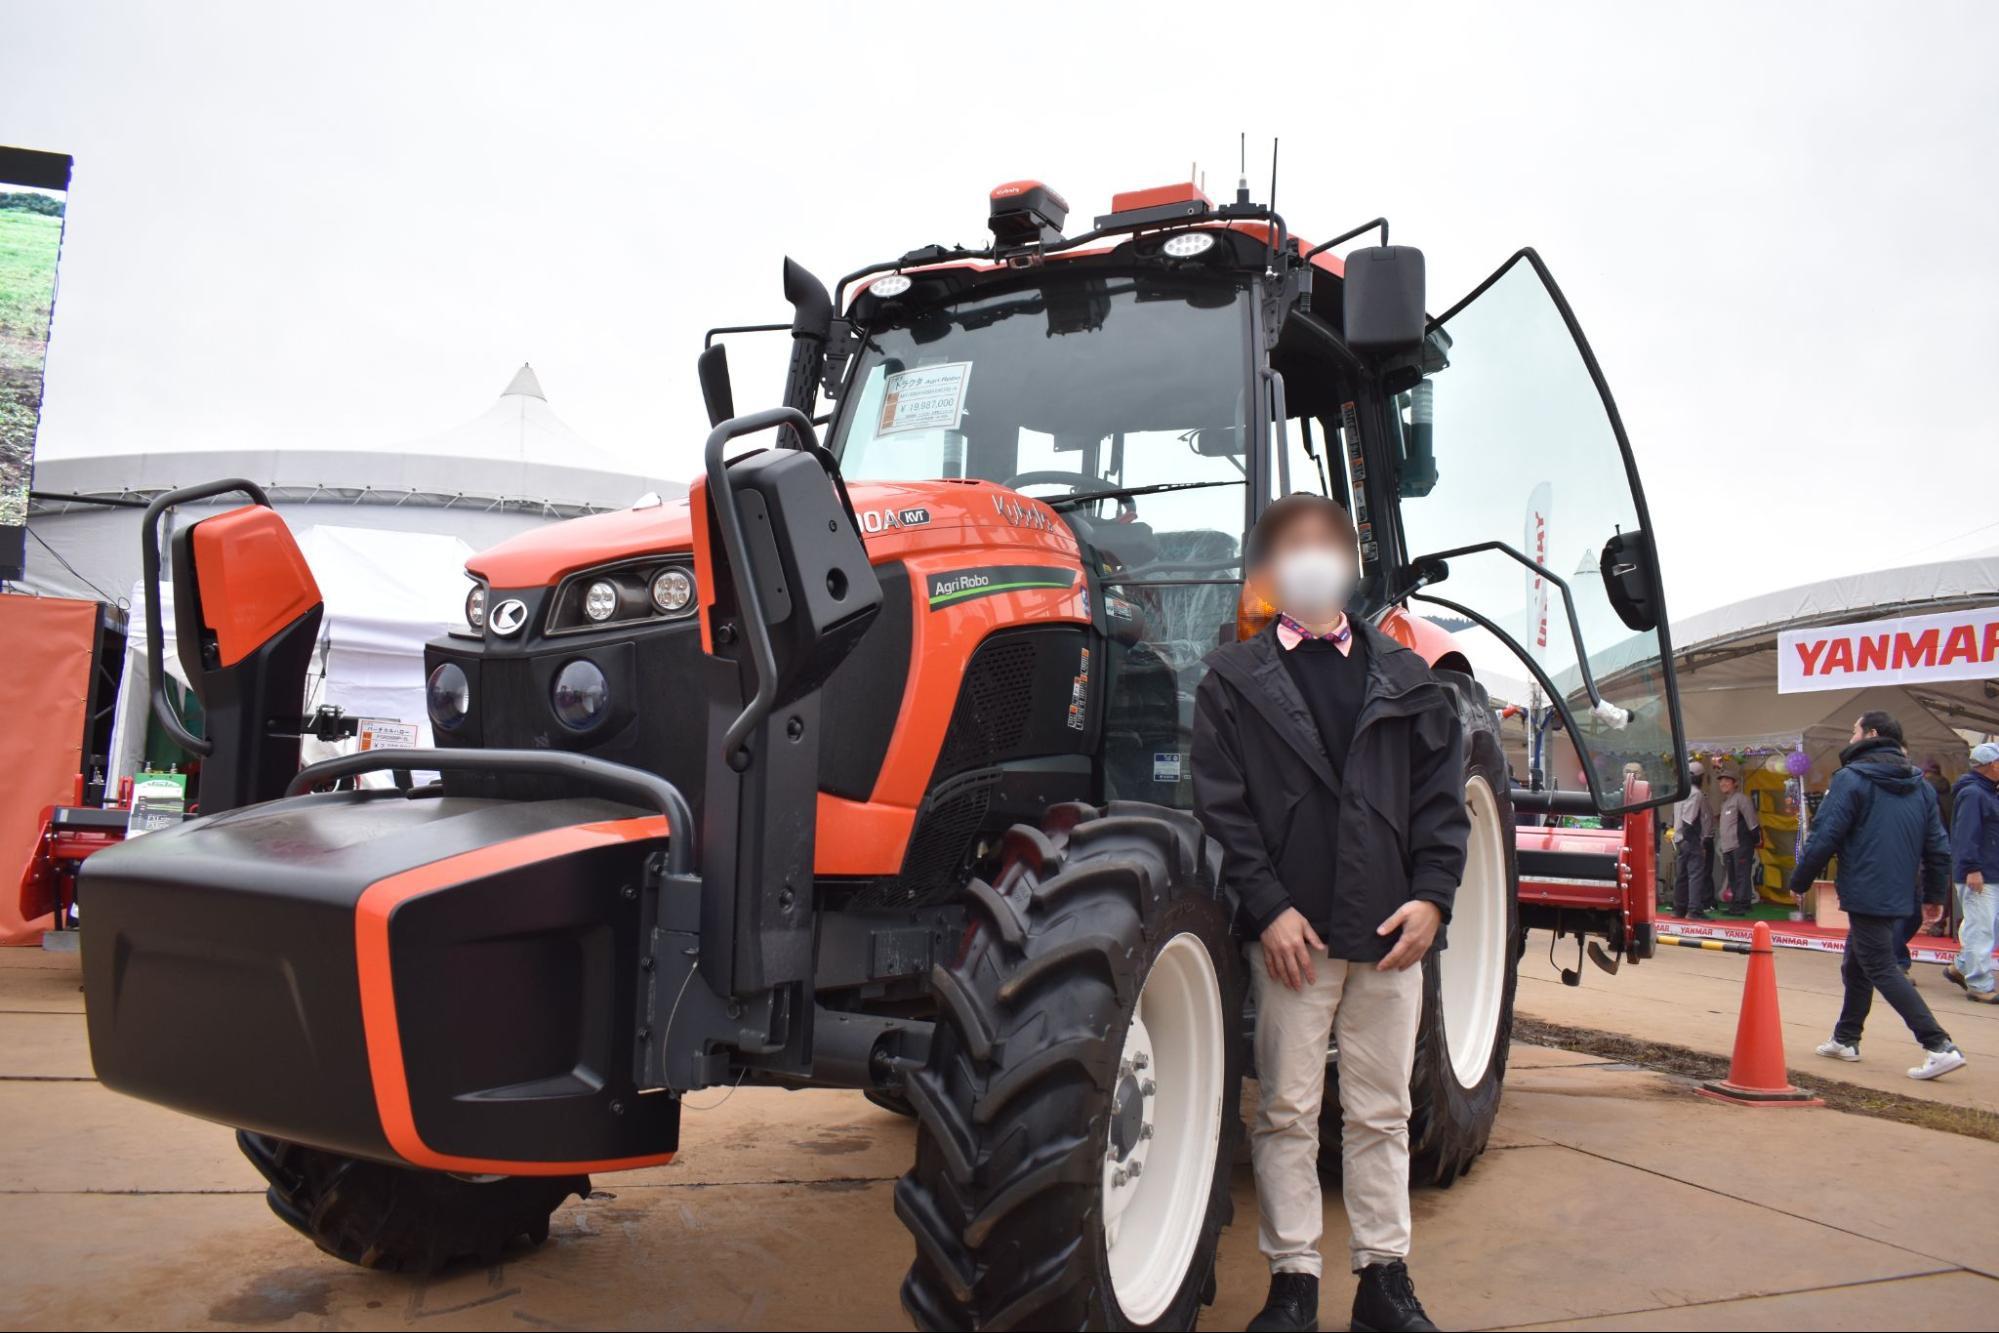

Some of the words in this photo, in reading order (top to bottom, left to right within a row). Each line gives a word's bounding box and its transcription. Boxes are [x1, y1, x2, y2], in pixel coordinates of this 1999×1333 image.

[904, 510, 925, 524] KVT
[935, 578, 960, 596] Agri
[960, 575, 989, 590] Robo
[1680, 925, 1713, 936] YANMAR
[1725, 929, 1753, 940] YANMA
[1771, 935, 1809, 946] YANMAR
